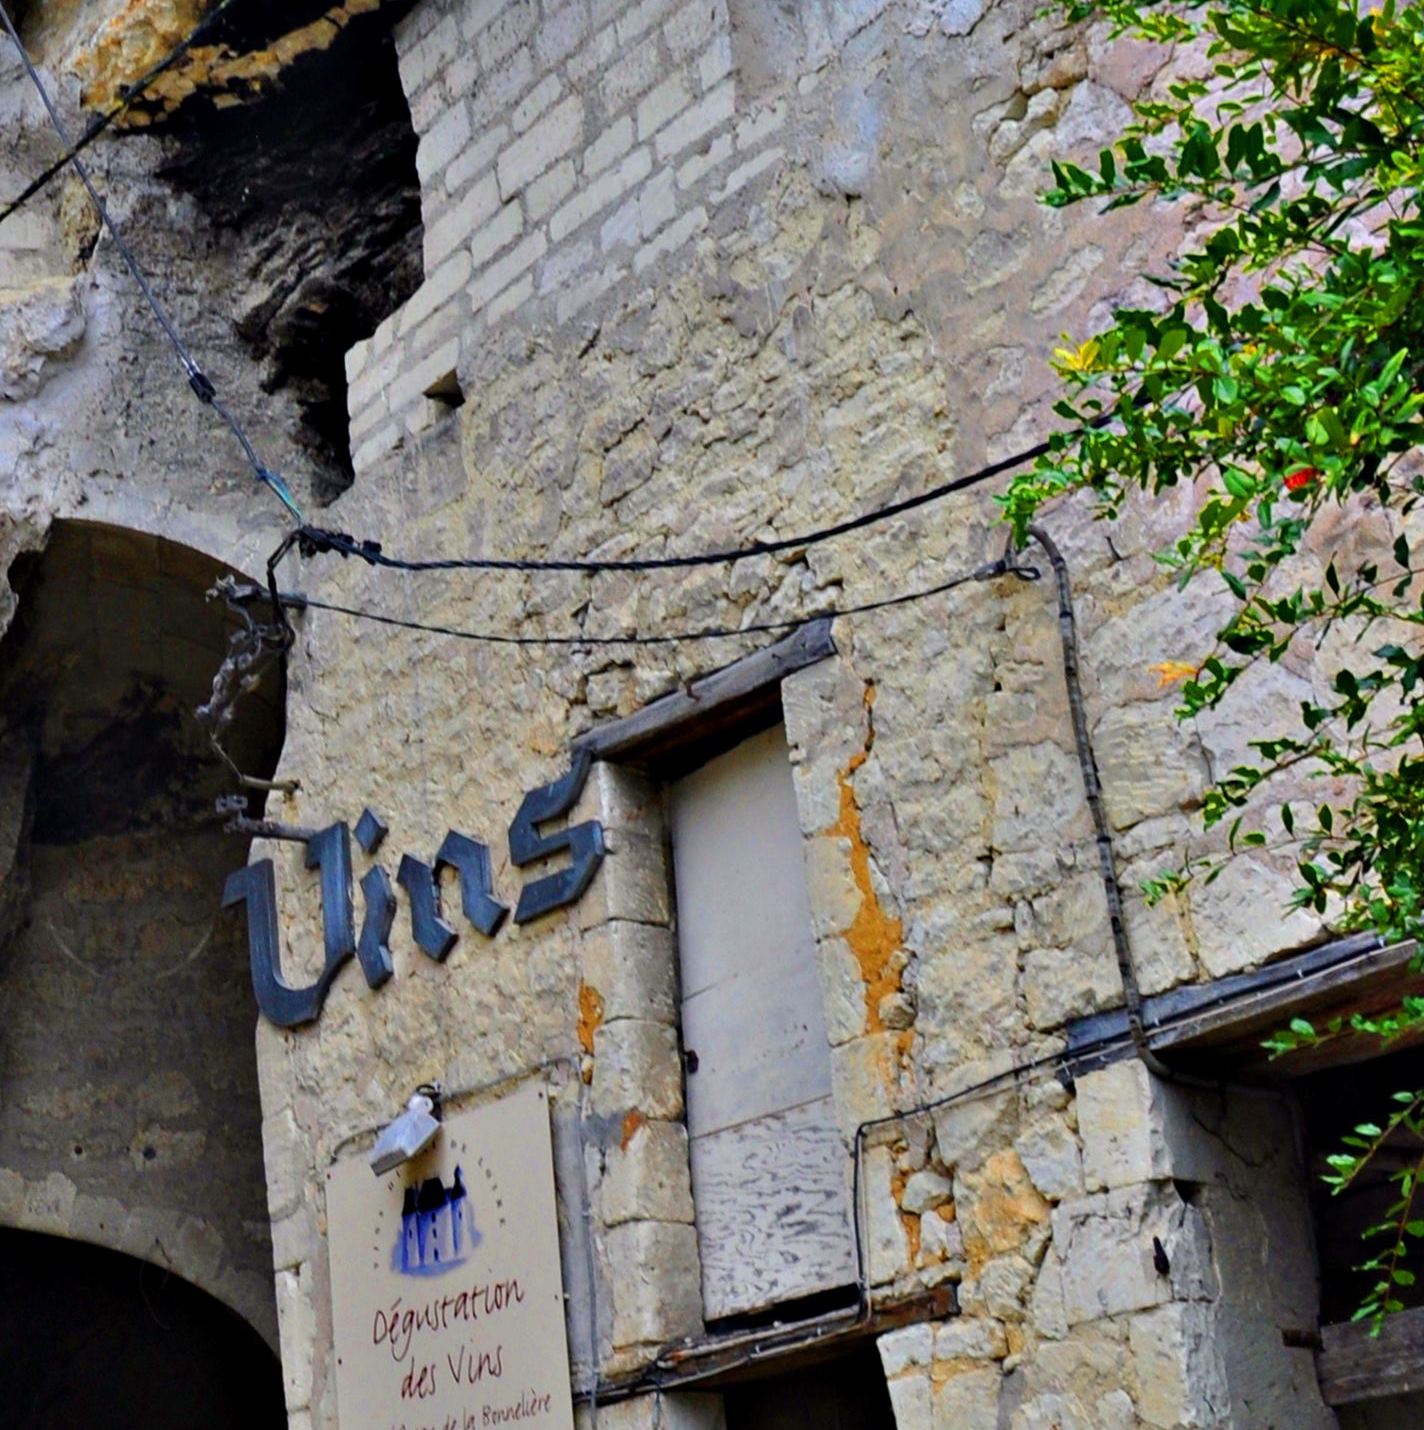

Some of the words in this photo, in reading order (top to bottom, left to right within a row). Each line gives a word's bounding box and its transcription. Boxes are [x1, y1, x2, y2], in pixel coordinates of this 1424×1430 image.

[373, 1278, 525, 1363] Dégustation
[401, 1356, 436, 1399] des
[447, 1338, 503, 1384] Vins
[482, 1387, 552, 1428] Bonnelière
